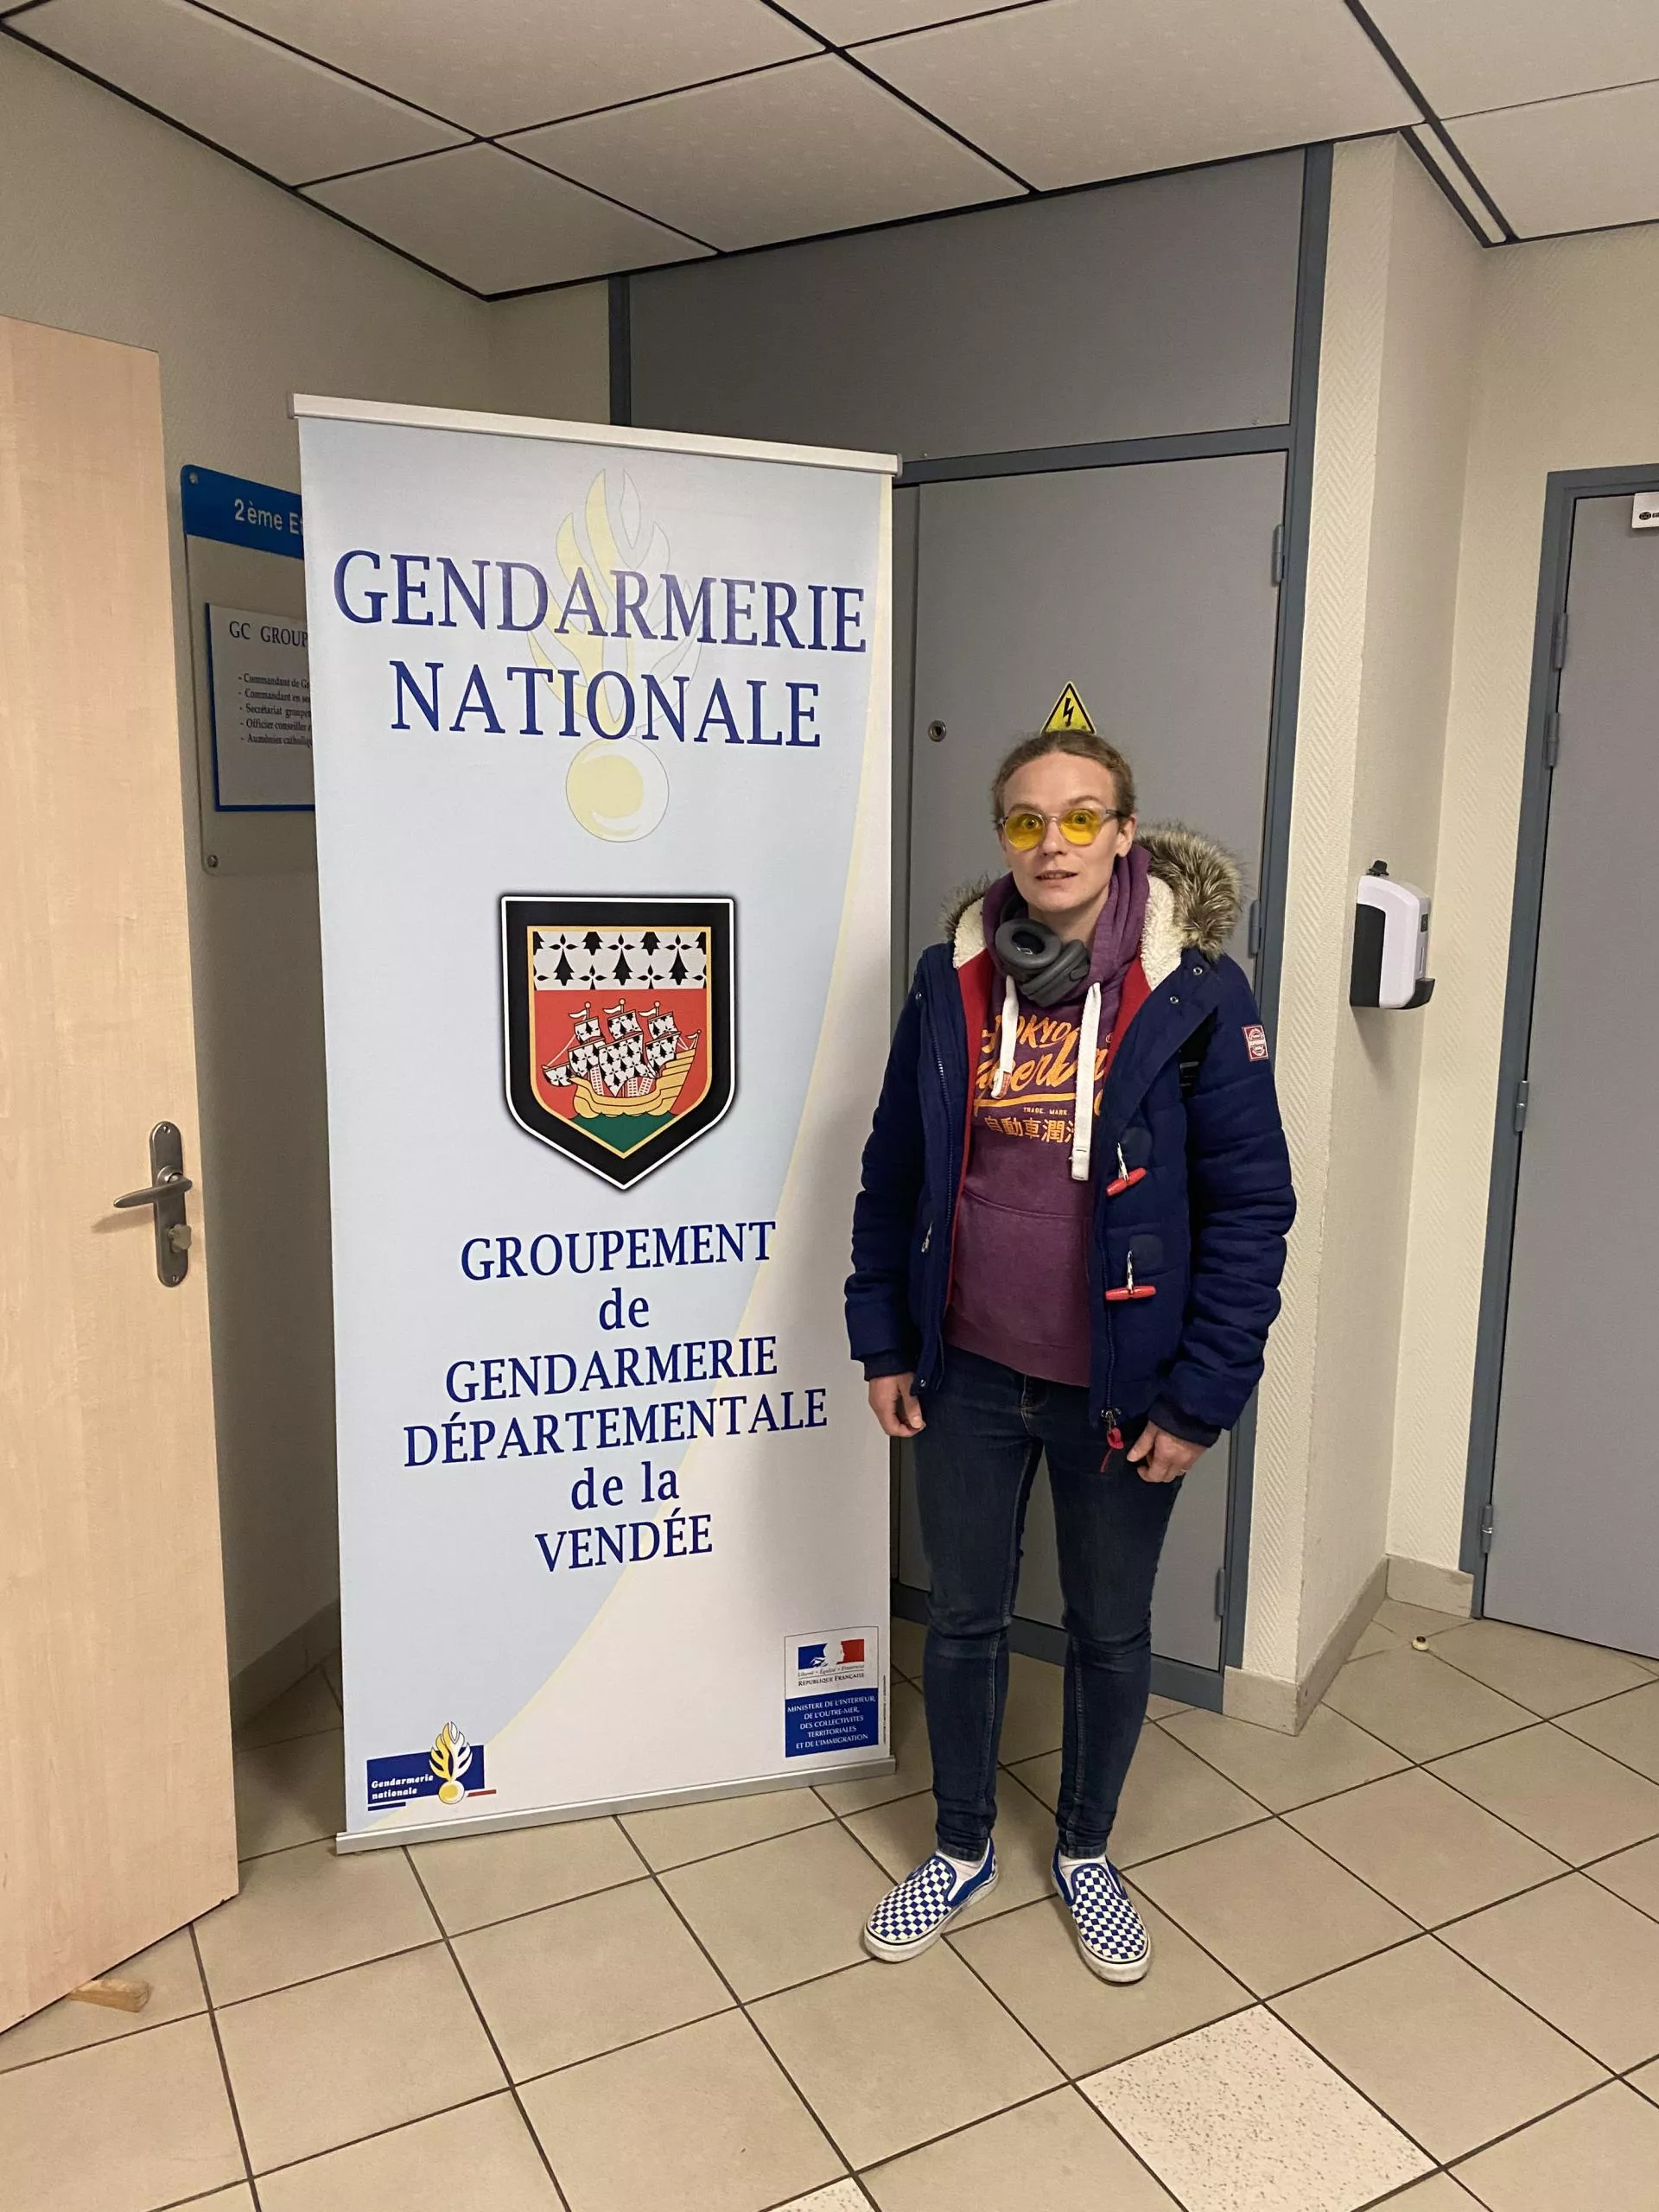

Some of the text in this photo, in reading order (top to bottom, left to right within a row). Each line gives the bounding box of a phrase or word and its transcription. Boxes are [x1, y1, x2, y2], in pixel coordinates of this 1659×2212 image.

[234, 499, 283, 531] 2ème
[334, 550, 866, 653] GENDARMERIE
[229, 620, 251, 640] GC
[390, 660, 821, 747] NATIONALE
[461, 1221, 776, 1281] GROUPEMENT
[599, 1287, 650, 1330] de
[446, 1336, 778, 1402] GENDARMERIE
[404, 1388, 828, 1467] DÉPARTEMENTALE
[571, 1461, 679, 1510] de la
[535, 1507, 713, 1572] VENDÉE
[807, 1726, 857, 1738] TERRITORIALES
[815, 1733, 868, 1746] L'IMMIGRATION
[371, 1774, 434, 1789] Gendarmerie
[372, 1787, 417, 1800] nationale
